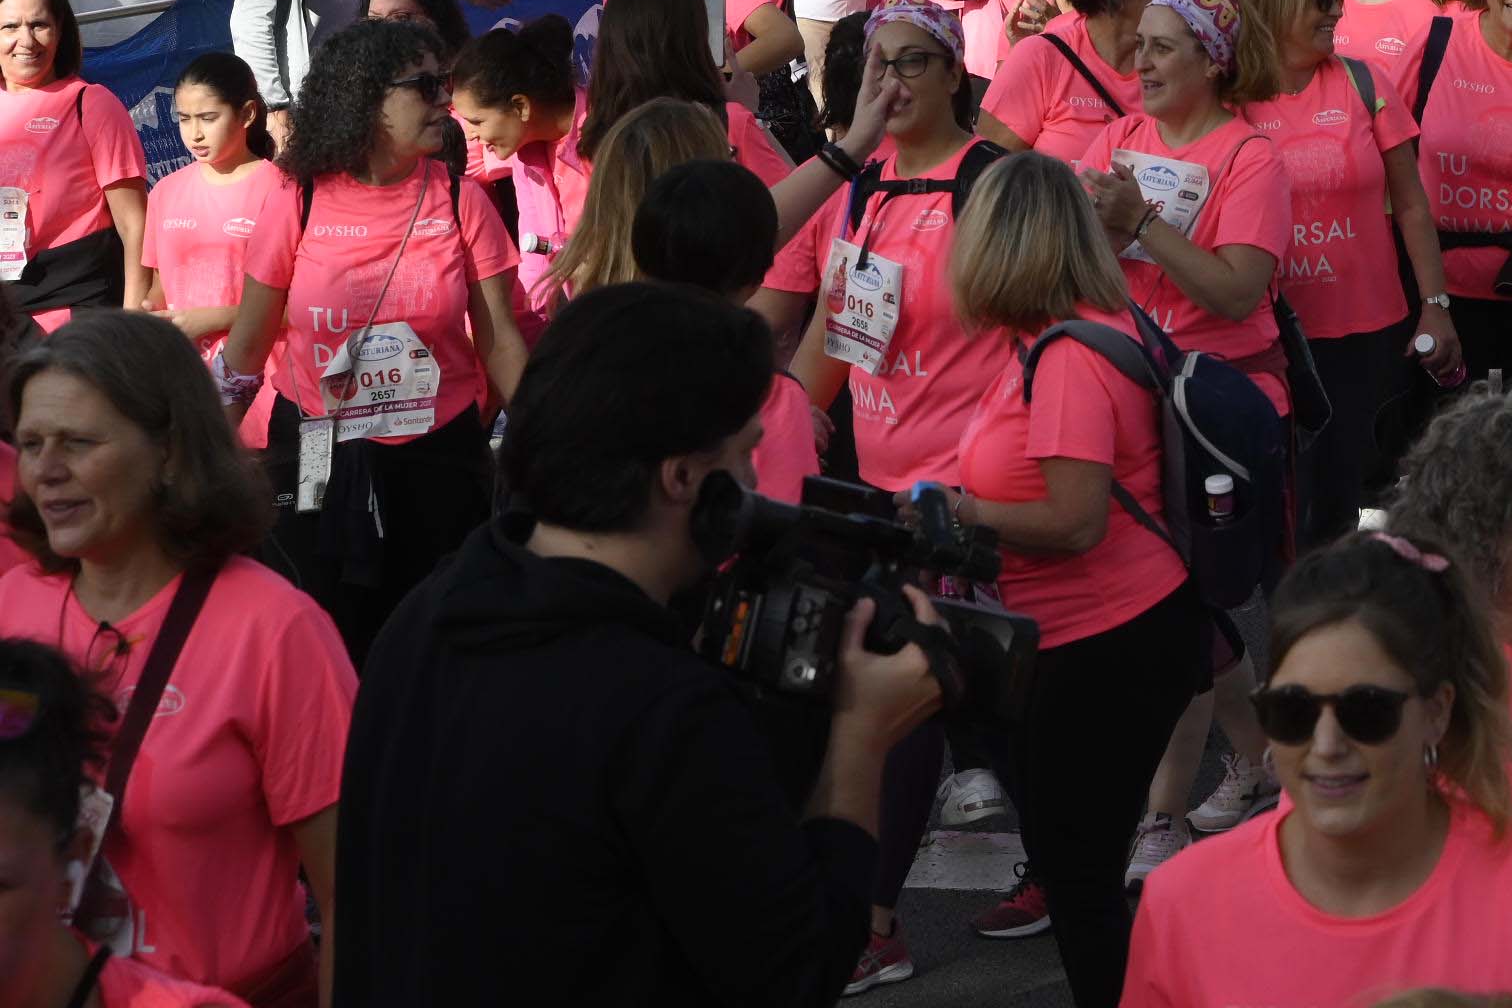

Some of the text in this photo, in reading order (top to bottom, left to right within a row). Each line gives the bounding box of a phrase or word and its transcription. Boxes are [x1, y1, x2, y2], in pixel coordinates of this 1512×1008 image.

[1453, 79, 1495, 94] OYSHO
[1437, 152, 1467, 176] TU
[314, 225, 368, 237] OYSHO
[1293, 217, 1357, 247] RSAL
[847, 294, 875, 318] 016
[308, 307, 348, 333] TU
[361, 368, 401, 388] 016
[371, 389, 396, 401] 2657
[340, 408, 372, 417] CARRERA
[338, 422, 373, 433] OYSHO
